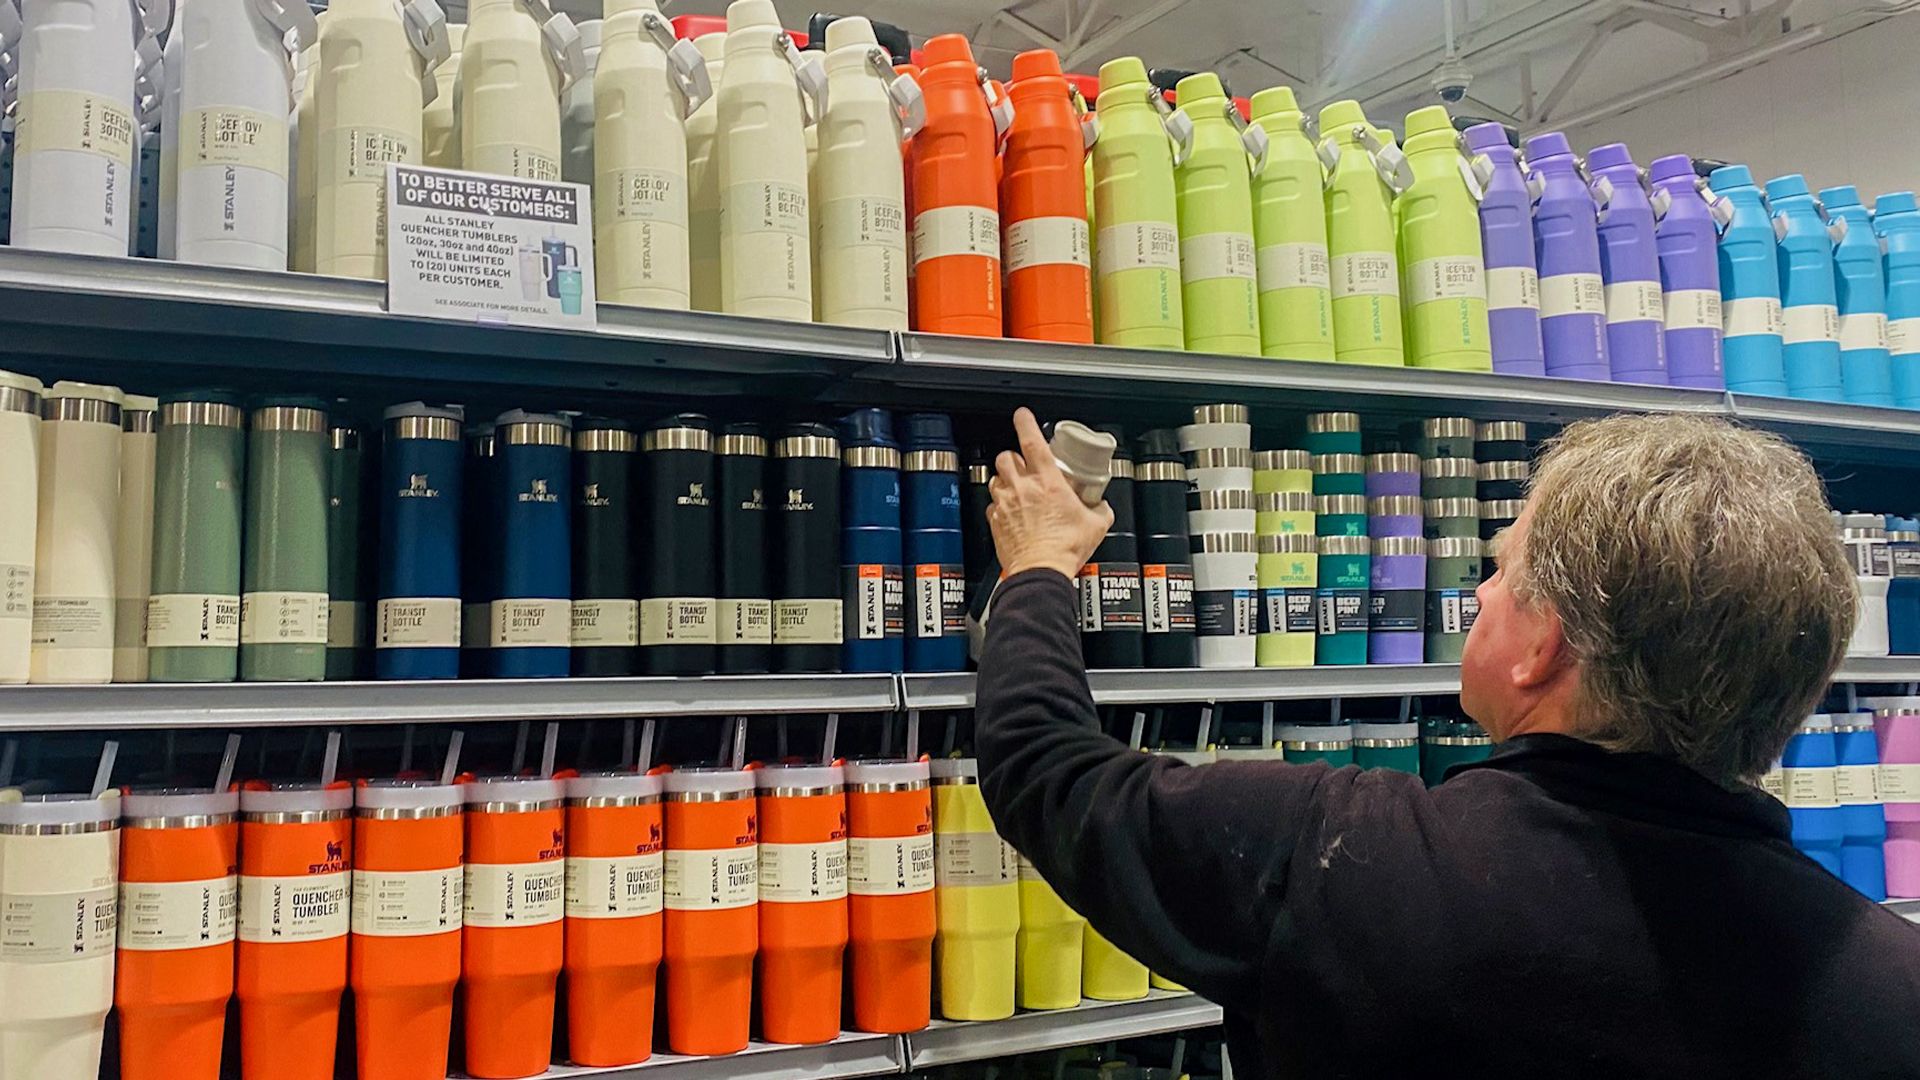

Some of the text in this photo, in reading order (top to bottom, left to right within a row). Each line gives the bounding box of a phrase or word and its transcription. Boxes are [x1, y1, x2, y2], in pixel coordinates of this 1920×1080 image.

[105, 158, 115, 216] STANLEY
[224, 165, 235, 220] STANLEY
[398, 172, 575, 205] TO BETTER SERVE ALL
[406, 188, 570, 220] OF OUR CUSTOMERS:
[425, 215, 494, 230] ALL STANLEY
[401, 223, 518, 244] QUENCHER TUMBLERS
[406, 235, 514, 256] (20oz, 30oz and 40oz)
[642, 222, 651, 270] STANLEY
[416, 248, 504, 266] WILL BE LIMITED
[786, 234, 796, 281] STANLEY
[410, 260, 511, 278] TO (20) UNITS EACH
[884, 248, 893, 294] STANLEY
[419, 272, 504, 289] PER CUSTOMER.
[434, 298, 448, 306] SEE
[449, 300, 485, 309] ASSOCIATE
[500, 304, 519, 312] MORE
[884, 580, 903, 592] TRA
[1101, 577, 1140, 588] TRAVEL
[867, 580, 875, 622] STANLEY
[924, 580, 933, 620] STANLEY
[1102, 588, 1131, 600] MUG
[1152, 580, 1160, 618] STANLEY
[1169, 591, 1192, 602] MUG
[1288, 595, 1311, 604] BEER
[1336, 597, 1361, 606] BEER
[393, 608, 426, 616] TRANSIT
[513, 608, 546, 616] TRANSIT
[572, 608, 600, 616] TRANSIT
[680, 606, 708, 614] TRANSIT
[780, 608, 808, 616] TRANSIT
[1288, 604, 1310, 614] PINT
[1336, 606, 1360, 615] PINT
[393, 617, 422, 626] BOTTLE
[512, 618, 540, 627] BOTTLE
[572, 618, 597, 626] BOTTLE
[680, 616, 705, 624] BOTTLE
[780, 616, 806, 625] BOTTLE
[896, 843, 904, 878] STANLEY
[292, 888, 344, 906] QUENCHER
[440, 874, 448, 914] STANLEY
[506, 870, 514, 910] STANLEY
[524, 888, 560, 904] TUMBLER
[202, 886, 210, 928] STANLEY
[272, 884, 281, 925] STANLEY
[292, 902, 339, 918] TUMBLER
[76, 898, 86, 940] STANLEY
